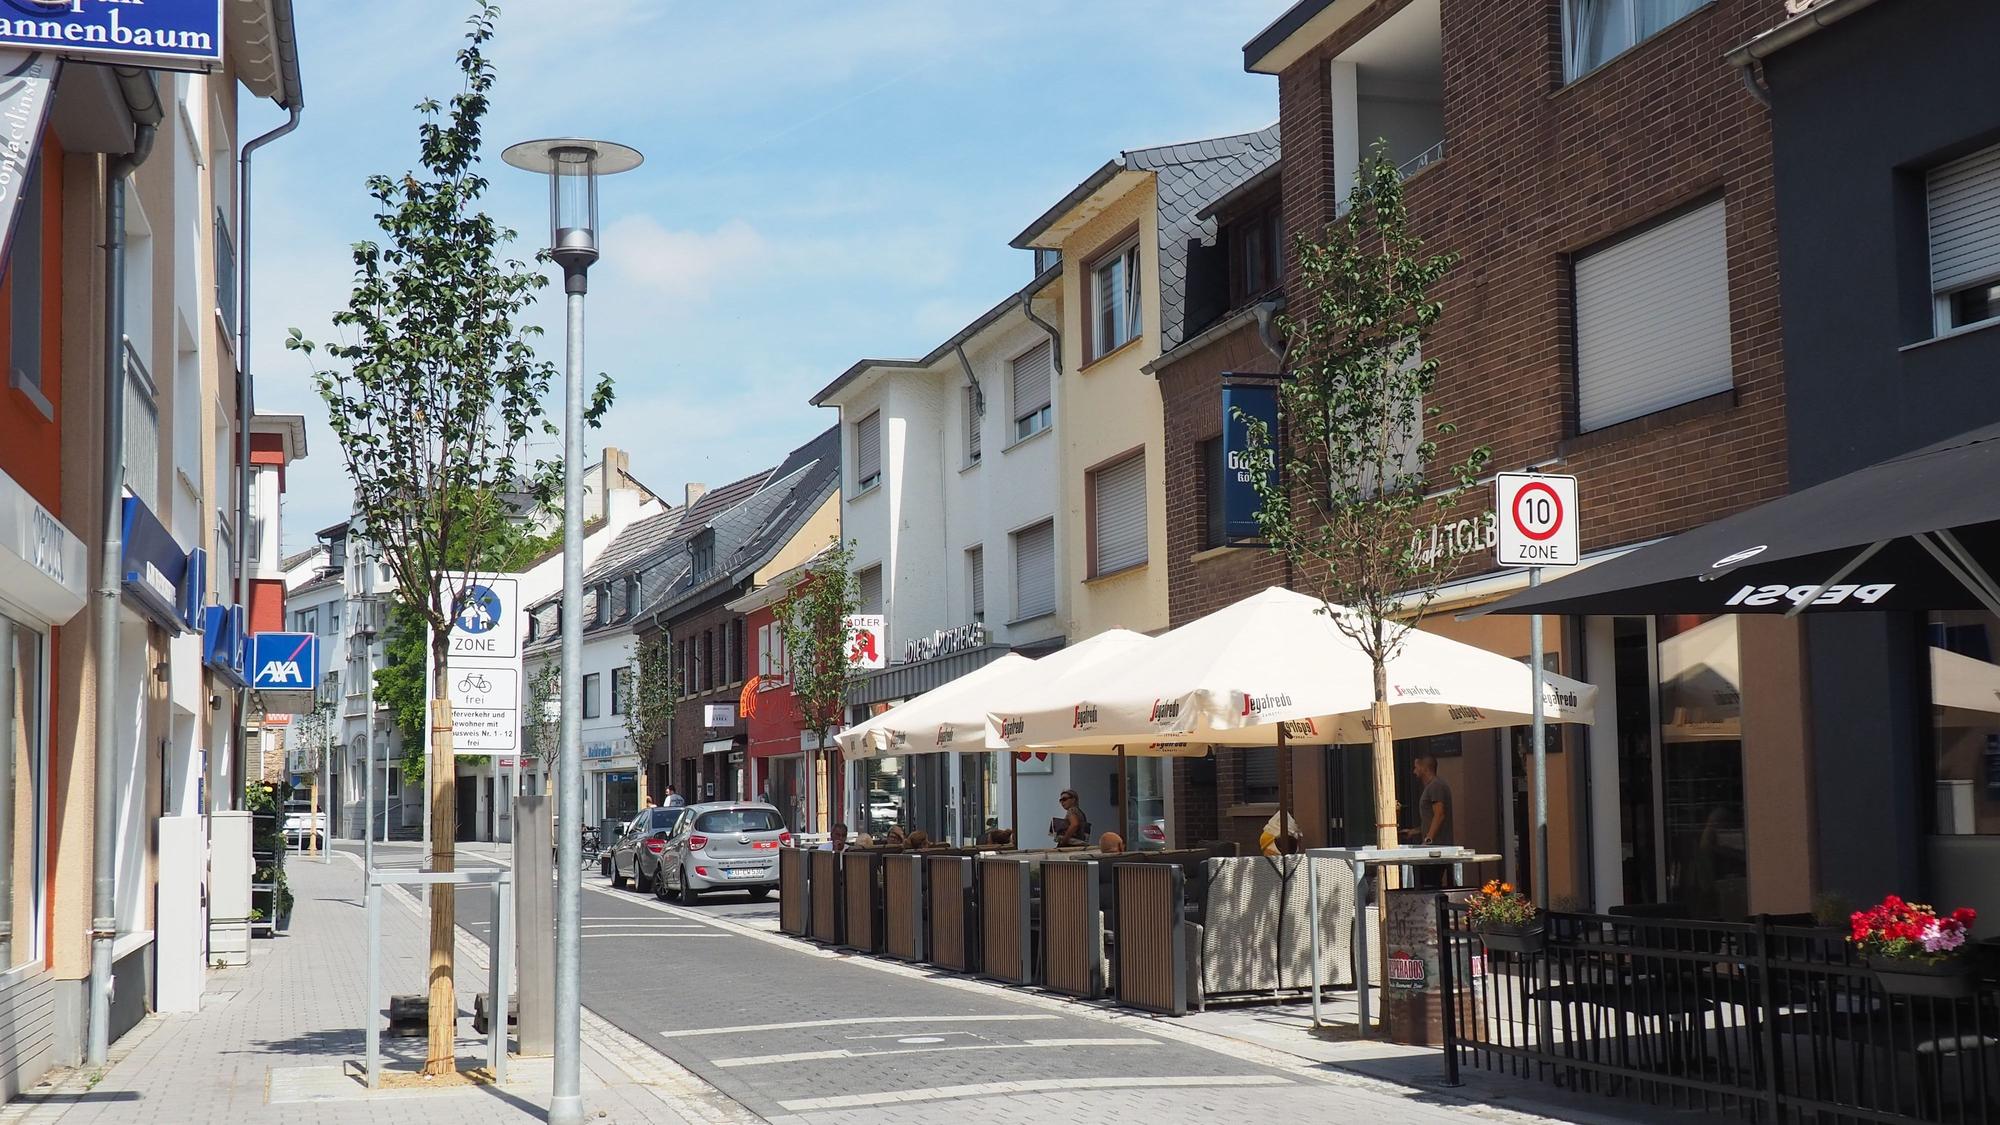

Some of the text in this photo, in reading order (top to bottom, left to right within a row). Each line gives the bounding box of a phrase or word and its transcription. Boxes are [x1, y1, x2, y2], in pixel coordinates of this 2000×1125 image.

[0, 8, 212, 50] annenbaum
[1525, 498, 1550, 525] 10
[1519, 545, 1558, 559] ZONE
[455, 638, 496, 652] ZONE
[255, 660, 303, 683] AXA
[465, 695, 485, 705] frei
[1241, 692, 1292, 716] Segafredo
[1543, 687, 1577, 708] egafredo
[467, 739, 480, 747] frei
